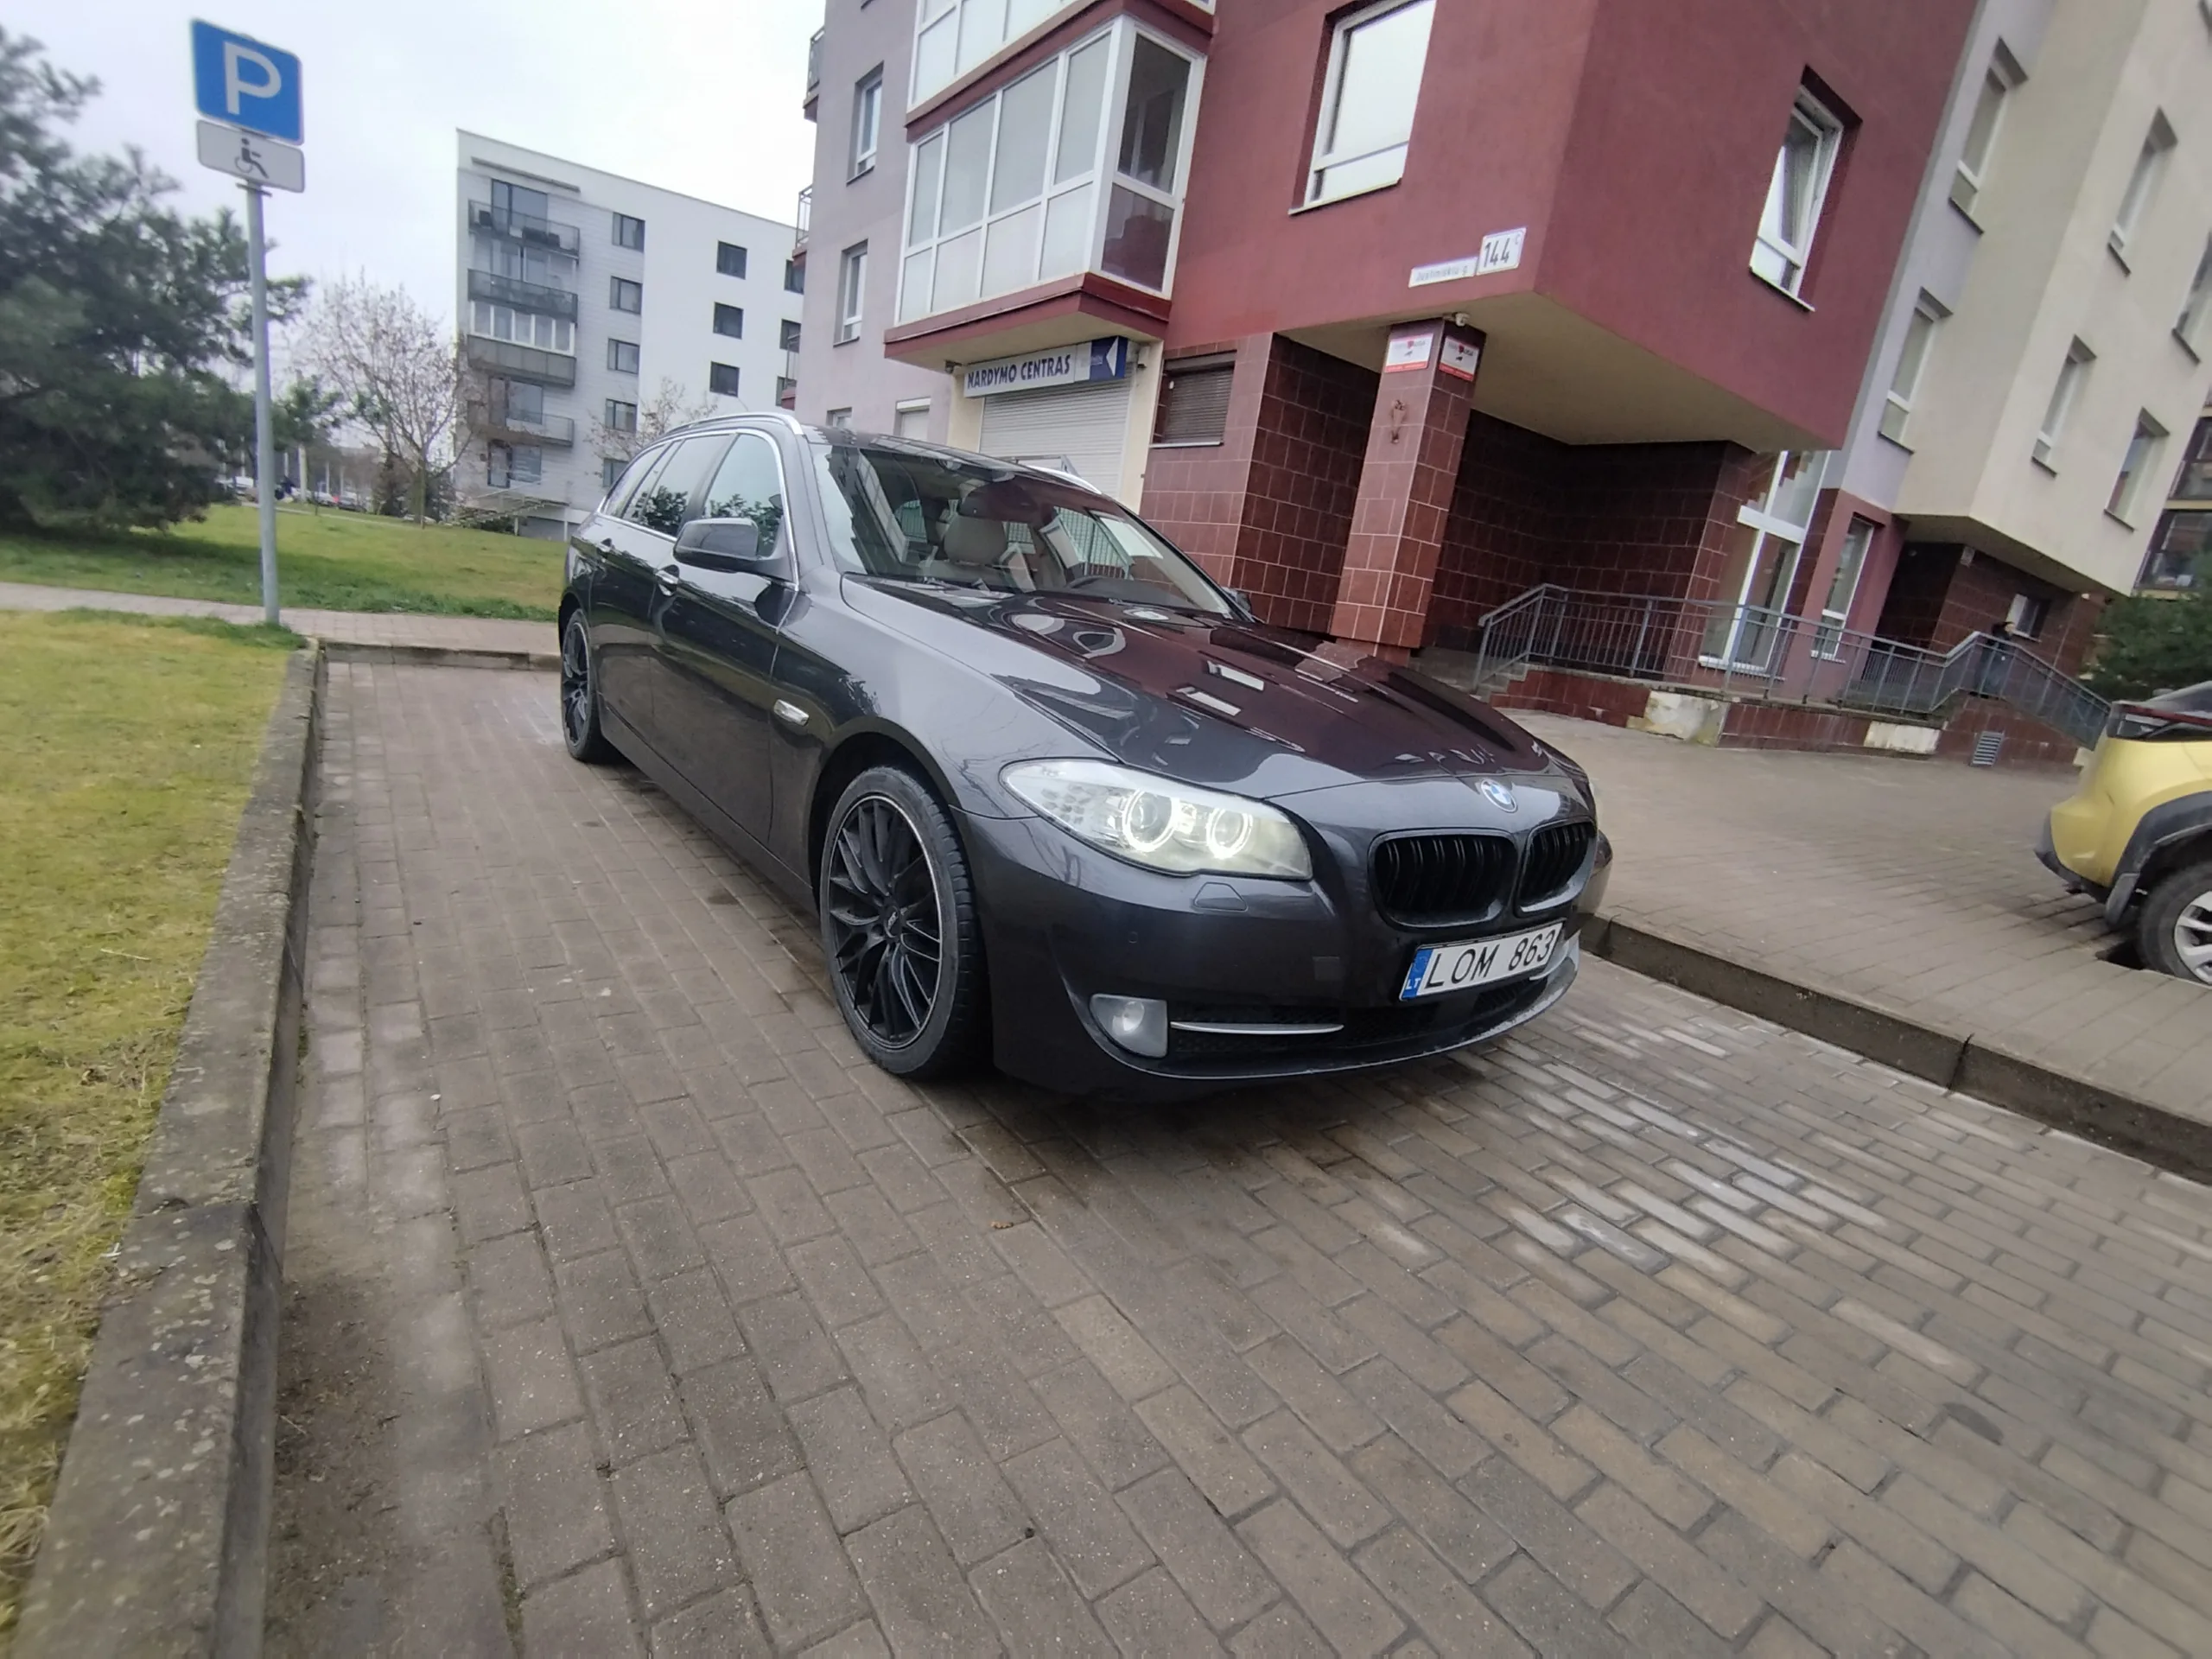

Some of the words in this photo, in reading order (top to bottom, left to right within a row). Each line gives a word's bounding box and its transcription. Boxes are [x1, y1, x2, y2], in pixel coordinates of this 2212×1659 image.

[224, 41, 282, 115] P
[1483, 237, 1511, 268] 144
[967, 364, 1017, 389] NARDYMO
[1020, 354, 1071, 380] CENTRAS
[1424, 944, 1501, 989] LOM
[1508, 929, 1556, 971] 863
[1405, 977, 1421, 990] LT
